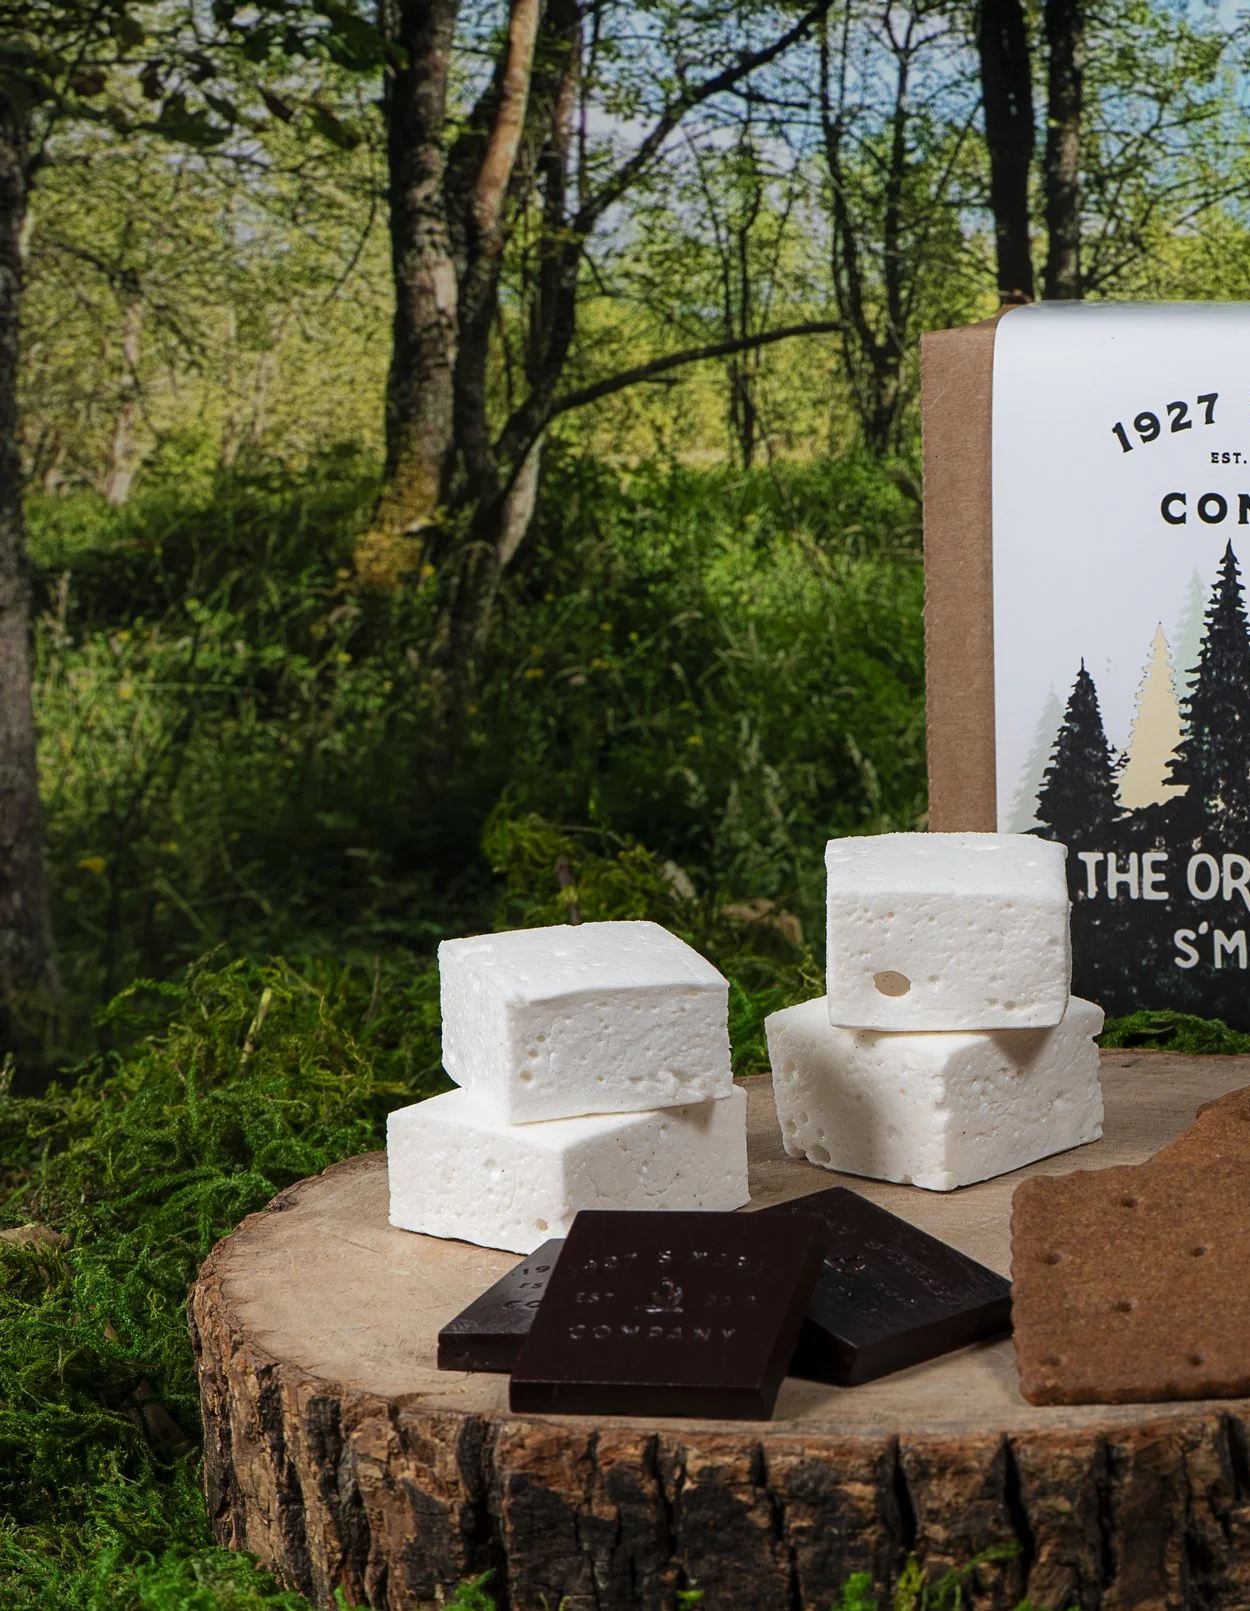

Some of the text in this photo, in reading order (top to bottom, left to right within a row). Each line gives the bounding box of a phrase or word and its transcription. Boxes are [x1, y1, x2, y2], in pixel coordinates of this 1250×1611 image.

[1112, 392, 1219, 453] 1927
[1210, 452, 1248, 464] EST.
[1077, 851, 1169, 901] THE
